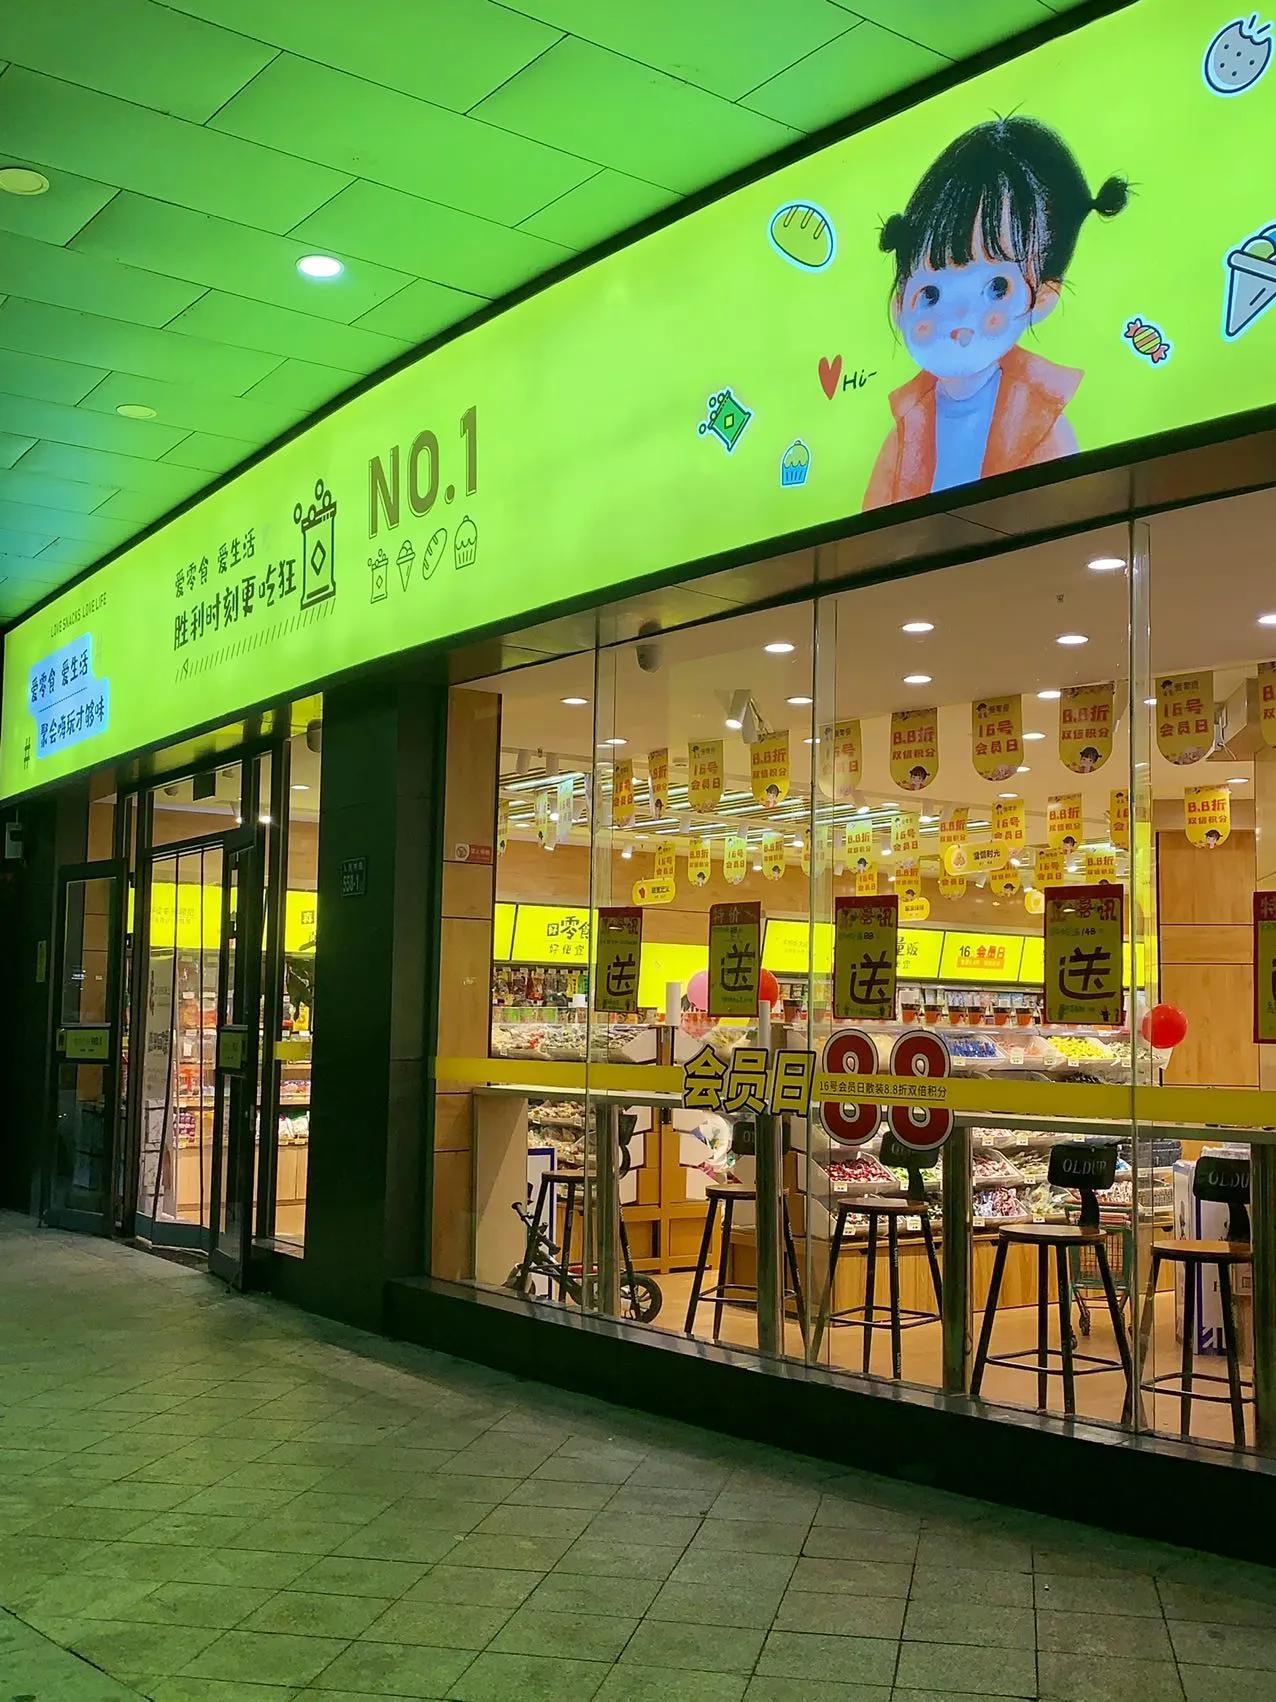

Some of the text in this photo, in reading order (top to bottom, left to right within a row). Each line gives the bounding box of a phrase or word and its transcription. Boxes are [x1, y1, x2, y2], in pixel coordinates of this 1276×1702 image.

[368, 405, 477, 539] NO.1
[175, 528, 256, 598] 爱零食 爱生活
[174, 558, 297, 651] 胜利时刻更吃狂
[51, 592, 107, 638] LOVE SNACKS LOVE LIFE
[31, 649, 88, 702] 爱零食 爱生活
[1062, 704, 1110, 724] 8.8折
[1164, 698, 1203, 718] 16号
[893, 726, 934, 745] 8.8折
[978, 720, 1013, 738] 16号
[1061, 727, 1110, 741] 双倍积分
[1160, 719, 1210, 738] 会员日
[975, 738, 1019, 756] 会员日
[752, 748, 787, 766] 8.8折
[693, 762, 719, 776] 16号
[691, 778, 721, 791] 会员日
[1049, 807, 1080, 821] 8.8折
[1188, 798, 1226, 813] 8.8折
[940, 819, 966, 831] 8.8折
[996, 816, 1020, 828] 16号
[895, 829, 916, 841] 16号
[994, 830, 1023, 840] 会员日
[1039, 862, 1059, 872] 16号
[1087, 855, 1114, 867] 8.8折
[607, 953, 636, 996] 送
[721, 943, 755, 991] 送
[1059, 946, 1116, 999] 送
[850, 950, 892, 1005] 送
[684, 1044, 816, 1117] 会员日
